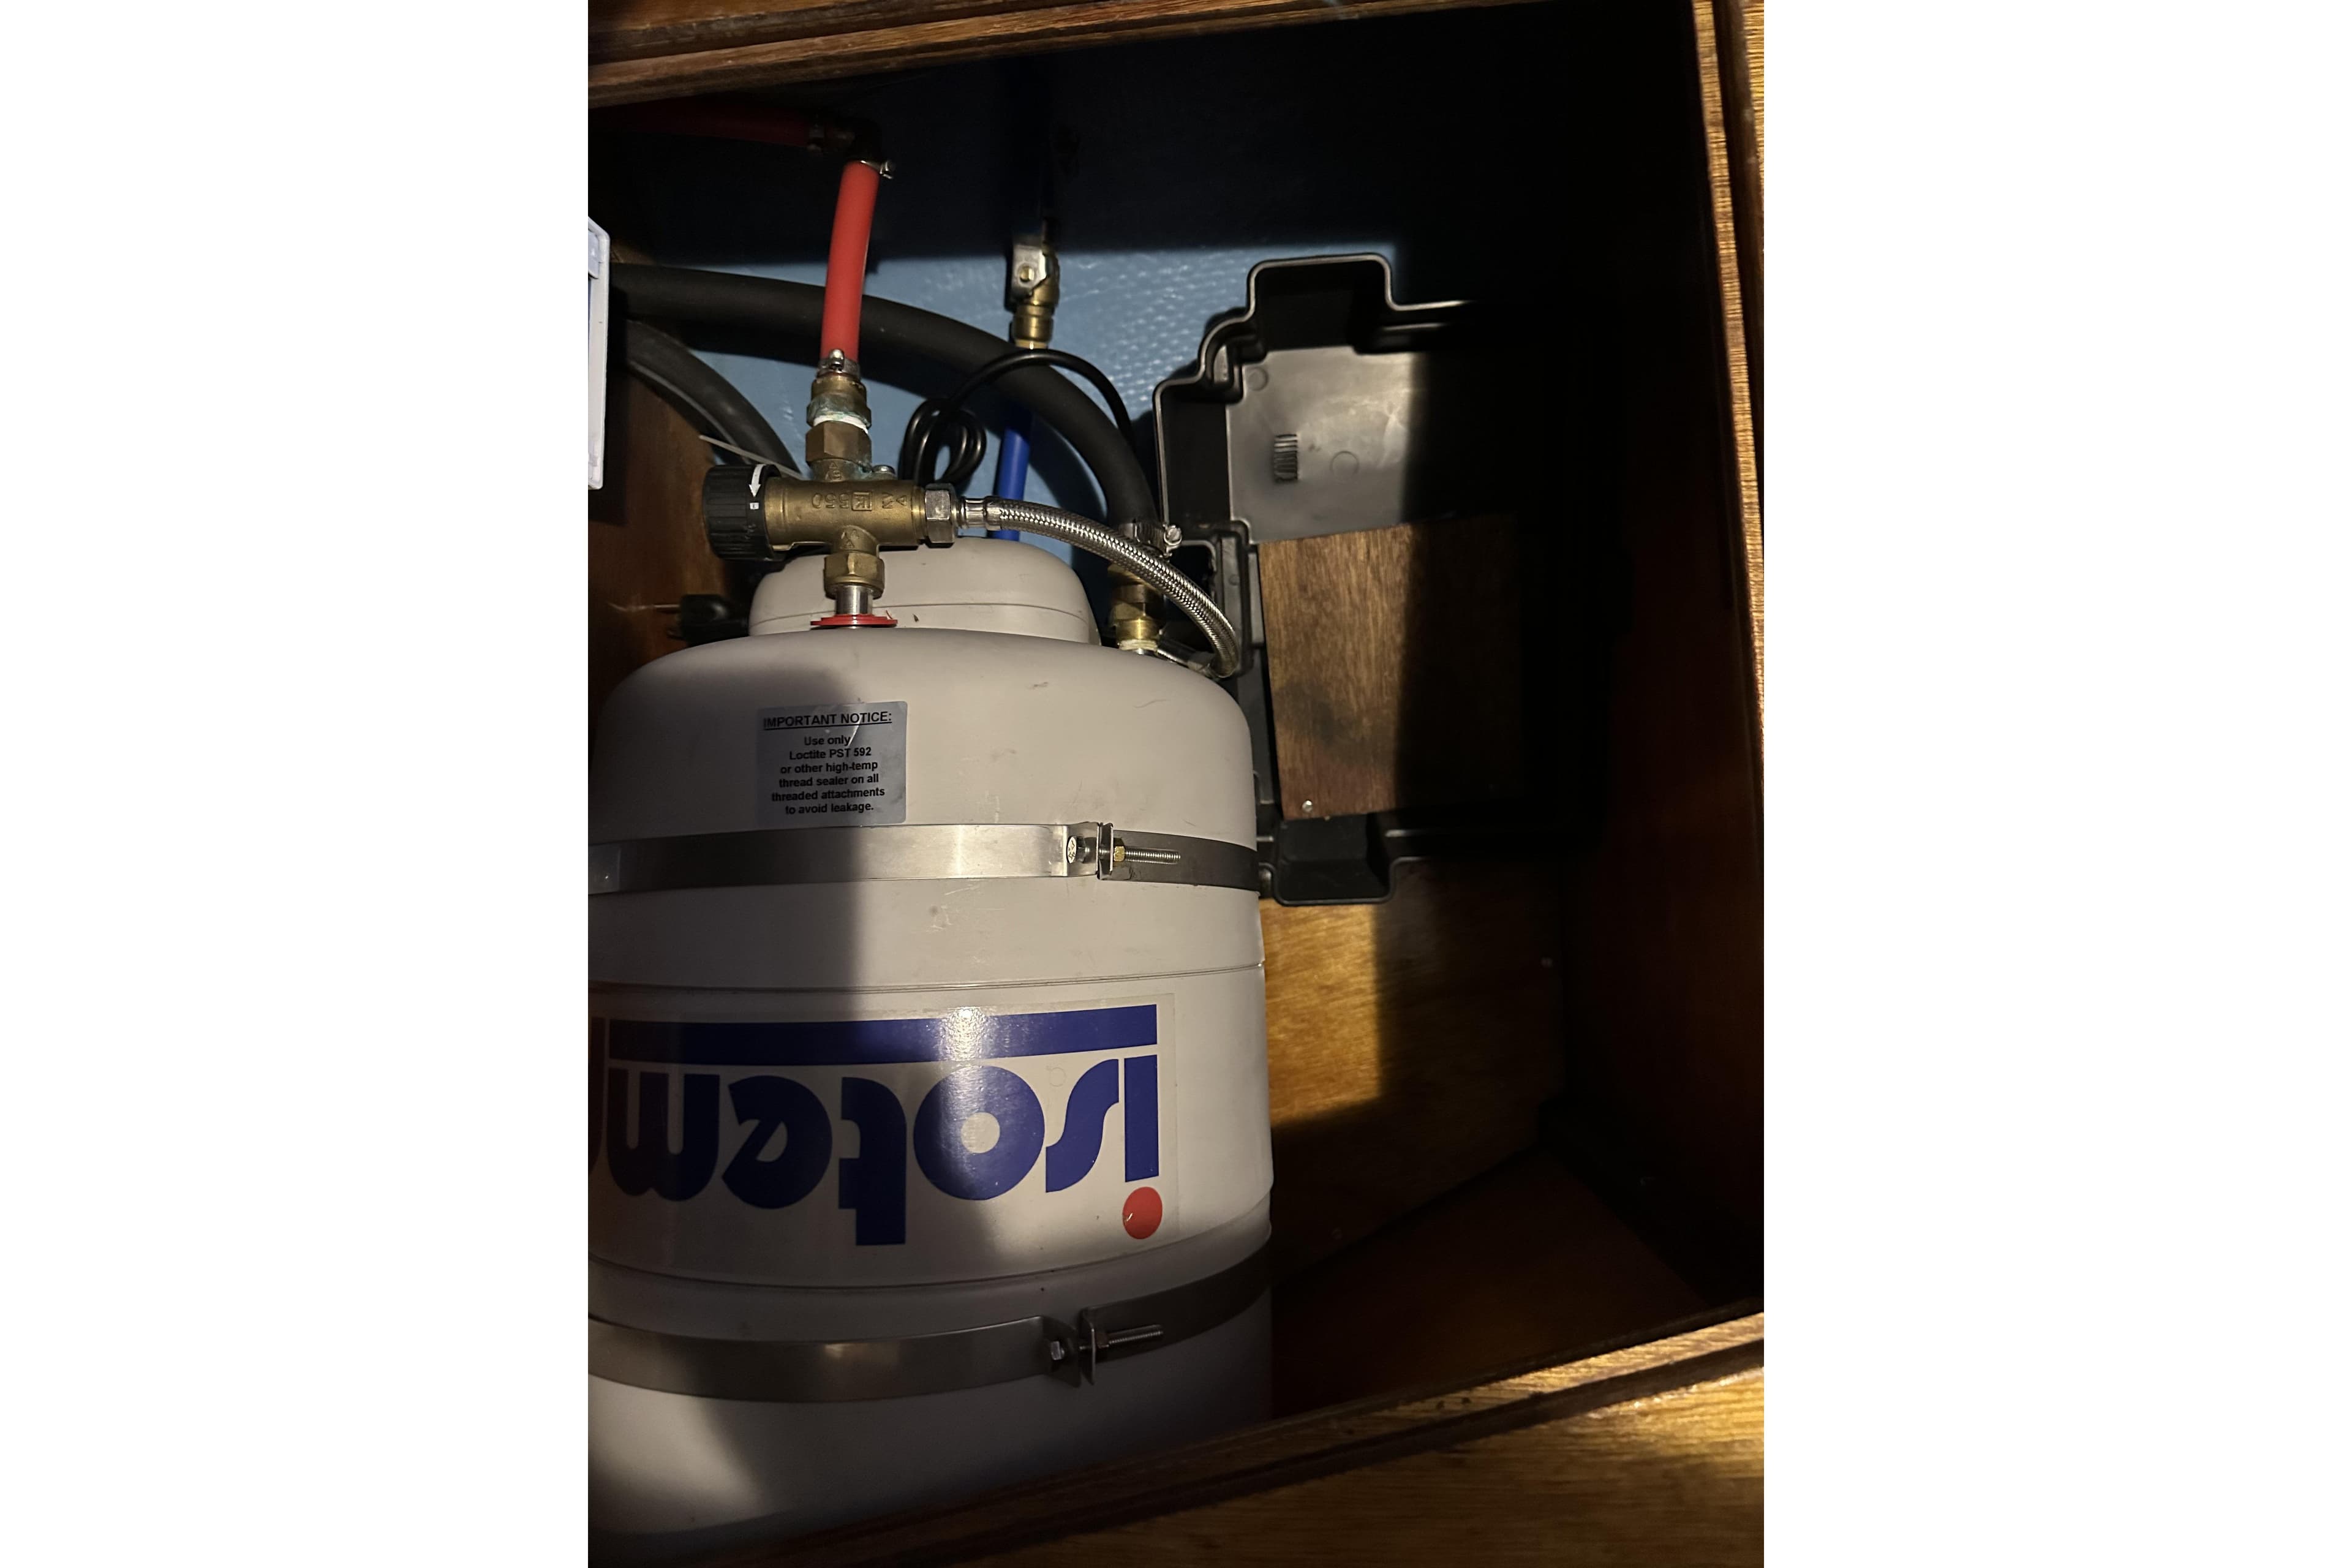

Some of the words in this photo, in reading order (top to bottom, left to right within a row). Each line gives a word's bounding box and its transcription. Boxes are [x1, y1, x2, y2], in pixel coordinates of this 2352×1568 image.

[812, 492, 849, 509] 550
[764, 714, 837, 728] IMPORTANT
[841, 712, 892, 724] NOTICE:
[804, 737, 824, 746] Use
[827, 736, 851, 746] only
[790, 750, 826, 760] Loctite
[829, 748, 851, 758] PST
[854, 747, 872, 757] 592
[780, 766, 791, 774] or
[794, 764, 823, 774] other
[826, 762, 878, 774] high-temp
[779, 777, 813, 788] thread
[816, 776, 848, 786] sealer
[867, 774, 879, 783] all
[772, 791, 818, 802] threaded
[821, 788, 885, 799] attachments
[785, 805, 796, 815] to
[799, 804, 827, 813] avoid
[831, 802, 874, 813] leakage.
